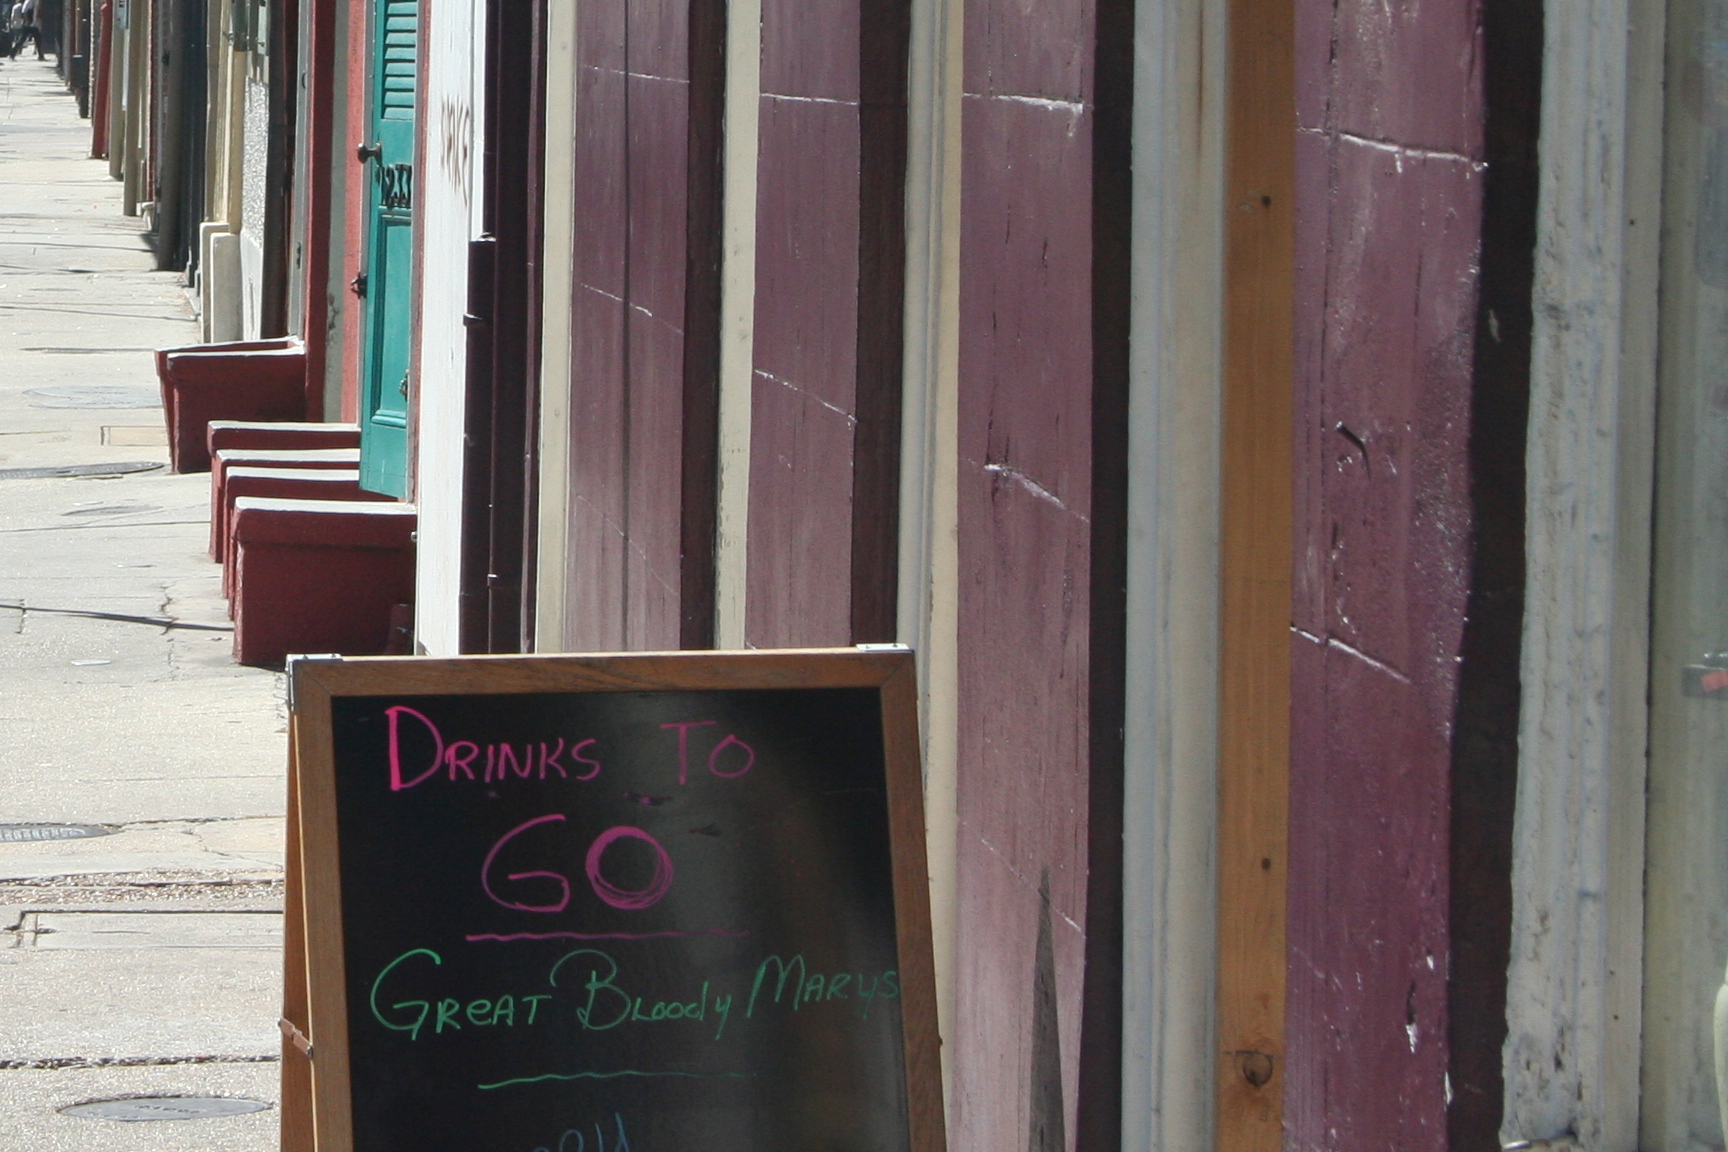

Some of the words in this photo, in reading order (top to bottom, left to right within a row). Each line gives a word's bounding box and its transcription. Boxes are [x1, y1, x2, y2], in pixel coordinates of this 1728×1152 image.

[384, 706, 601, 791] DRINKS
[659, 720, 755, 786] TO
[481, 813, 674, 912] GO
